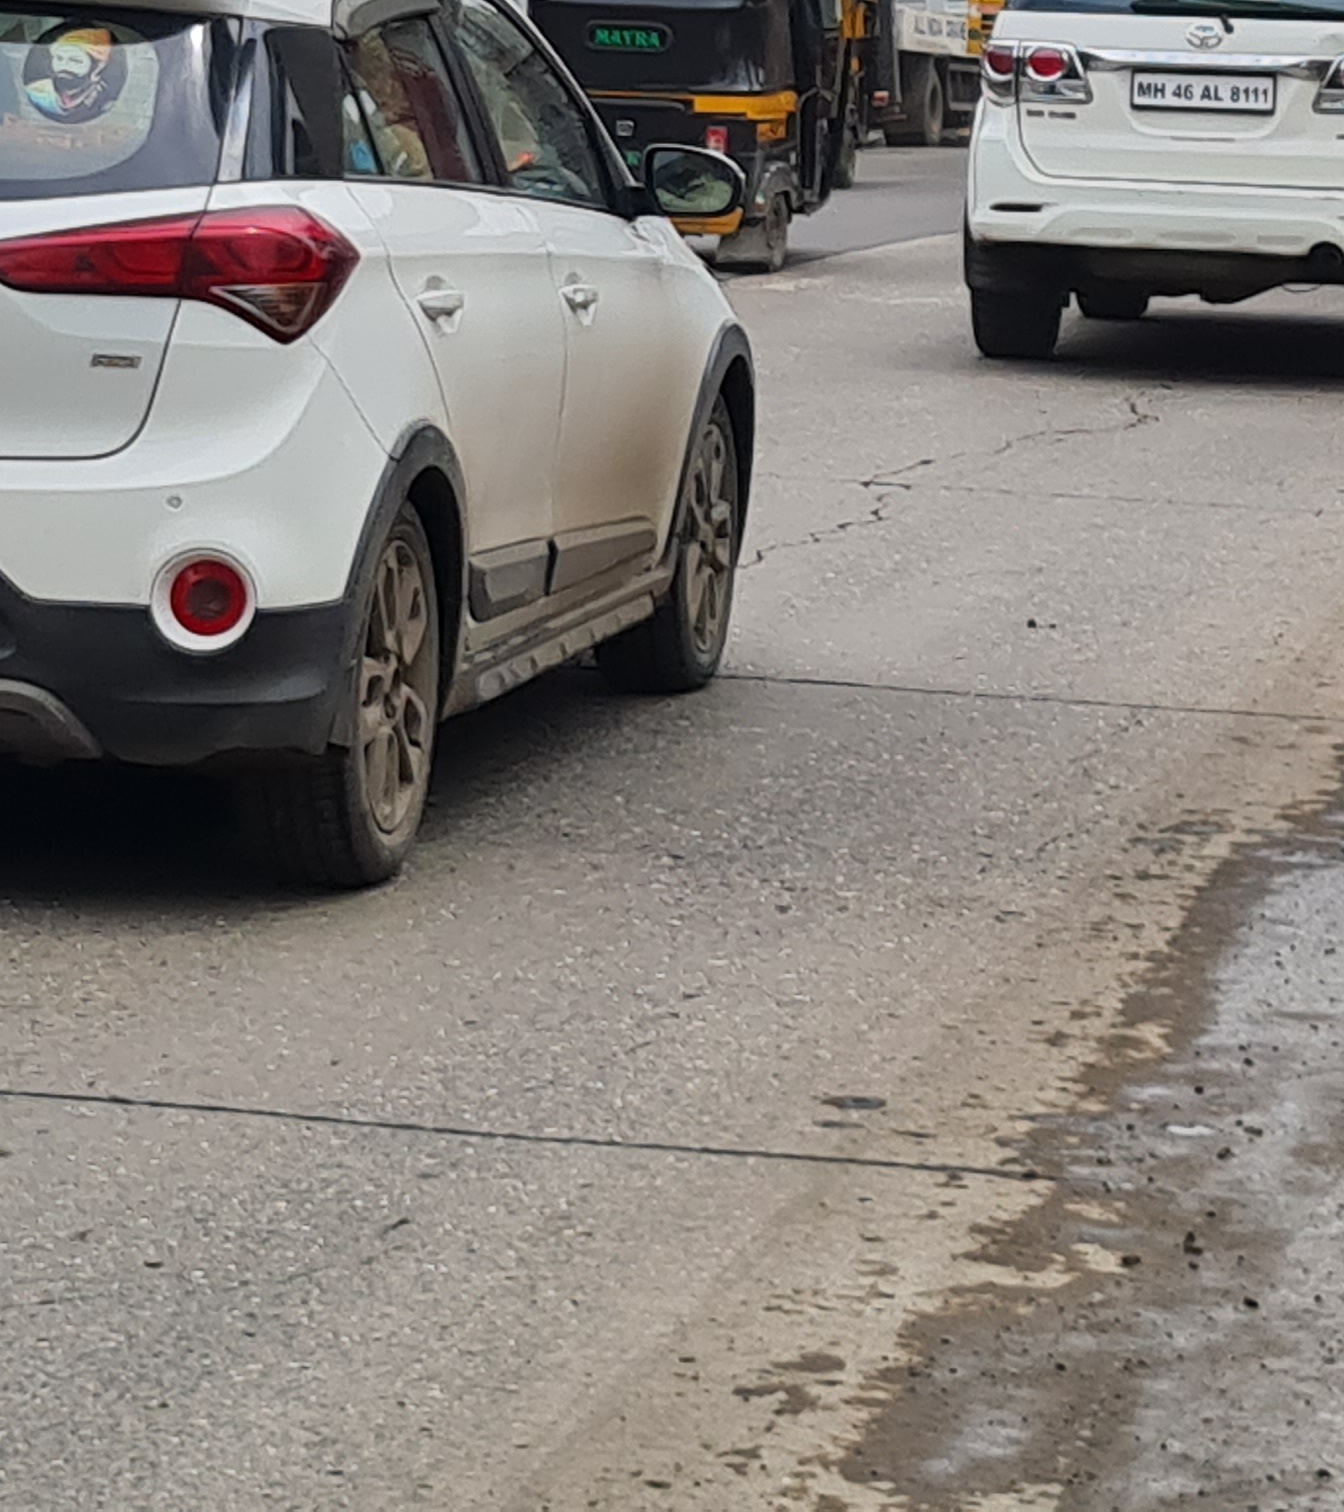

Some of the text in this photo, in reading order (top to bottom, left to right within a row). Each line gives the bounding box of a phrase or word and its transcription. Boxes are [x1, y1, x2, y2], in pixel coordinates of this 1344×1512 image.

[1137, 81, 1269, 104] MH 46 AL 8111
